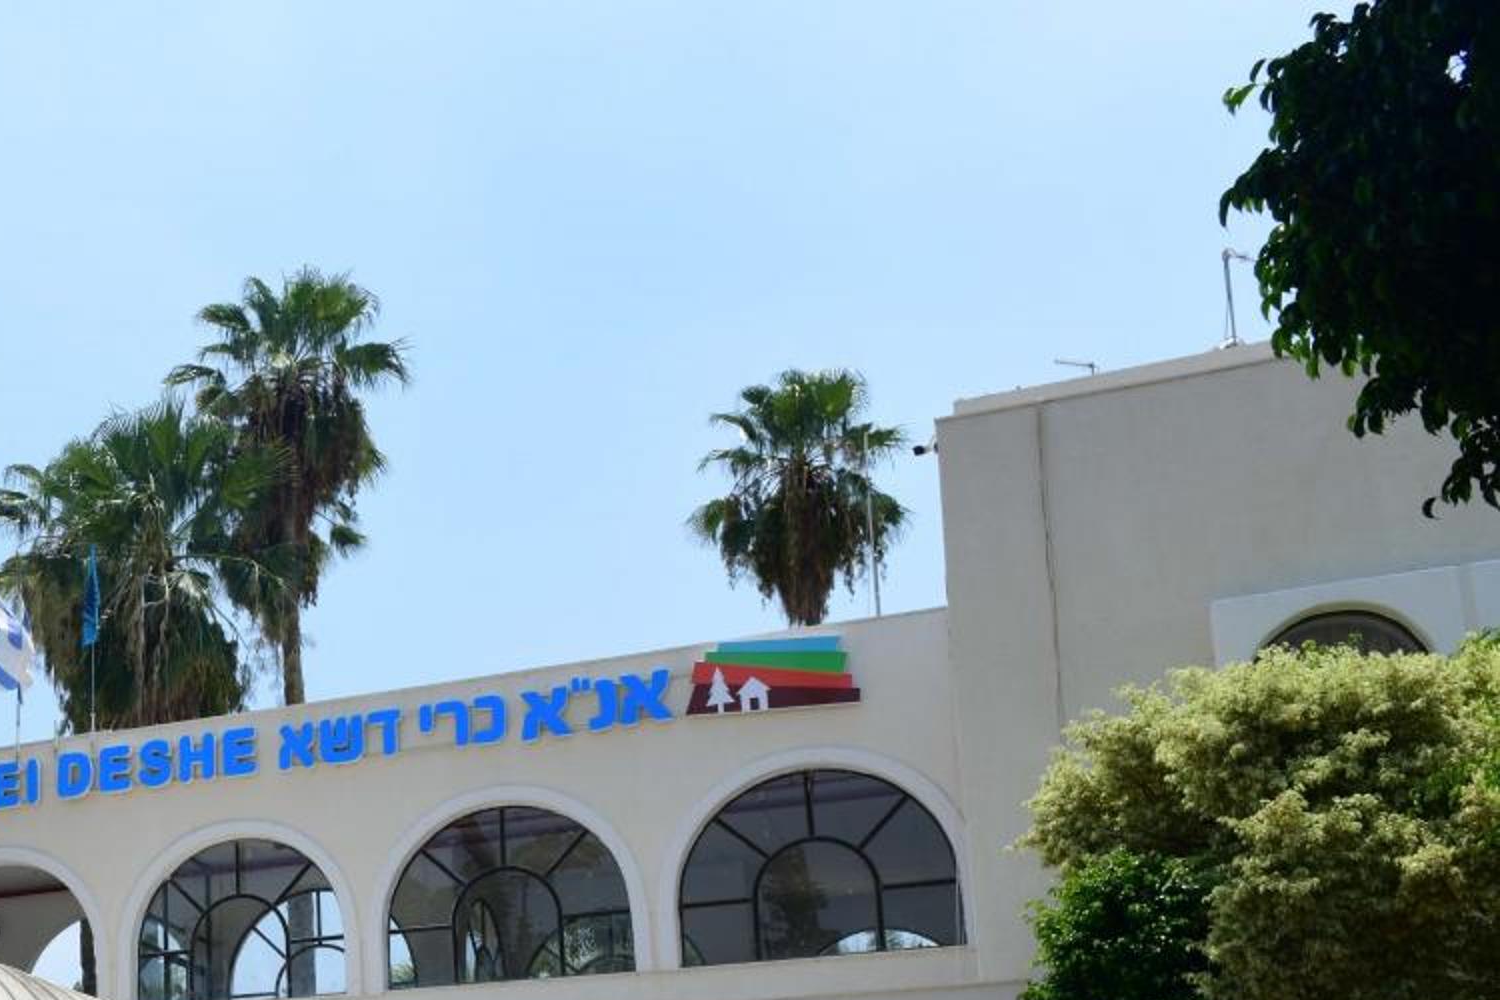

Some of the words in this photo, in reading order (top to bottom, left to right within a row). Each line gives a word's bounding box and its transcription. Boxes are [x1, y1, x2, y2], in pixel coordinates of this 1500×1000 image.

[278, 707, 401, 770] דשא
[419, 692, 508, 746] כרי
[55, 725, 257, 798] DESHE
